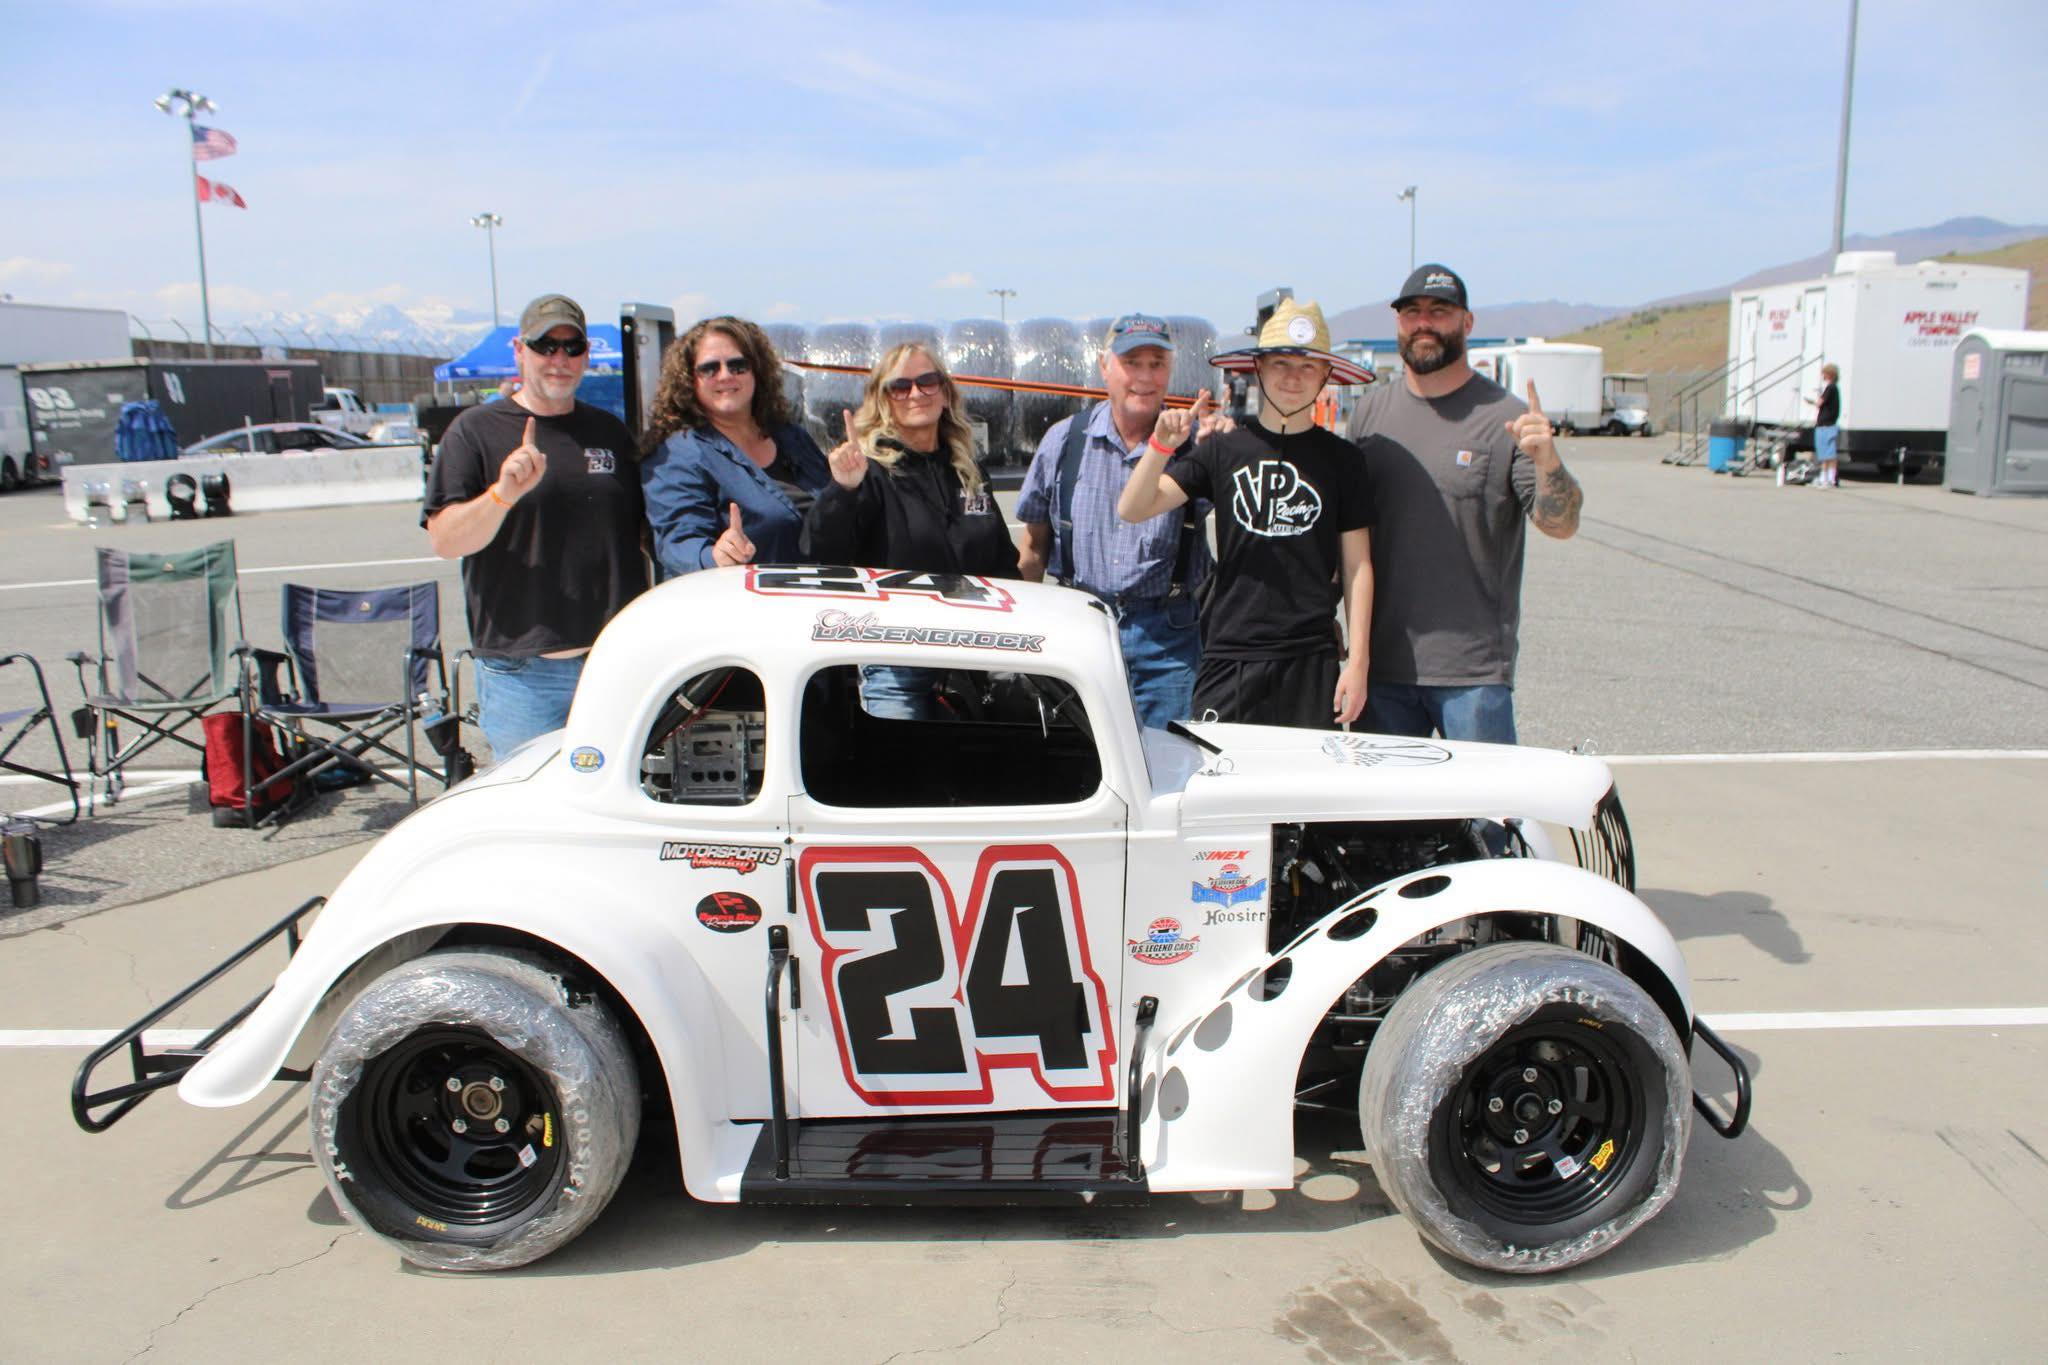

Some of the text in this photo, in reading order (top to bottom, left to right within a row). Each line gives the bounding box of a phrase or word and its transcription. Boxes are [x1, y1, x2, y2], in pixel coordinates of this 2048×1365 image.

[1904, 310, 1979, 324] APPLE VALLEY
[28, 387, 75, 410] 93
[1231, 460, 1299, 536] VP
[744, 563, 1017, 613] 24
[660, 842, 782, 865] MOTORSPORTS
[1205, 850, 1251, 861] INEX
[1202, 907, 1267, 926] Hoosier
[1145, 943, 1173, 953] LEGEND
[1173, 942, 1196, 952] CARS
[799, 844, 1118, 1107] 24
